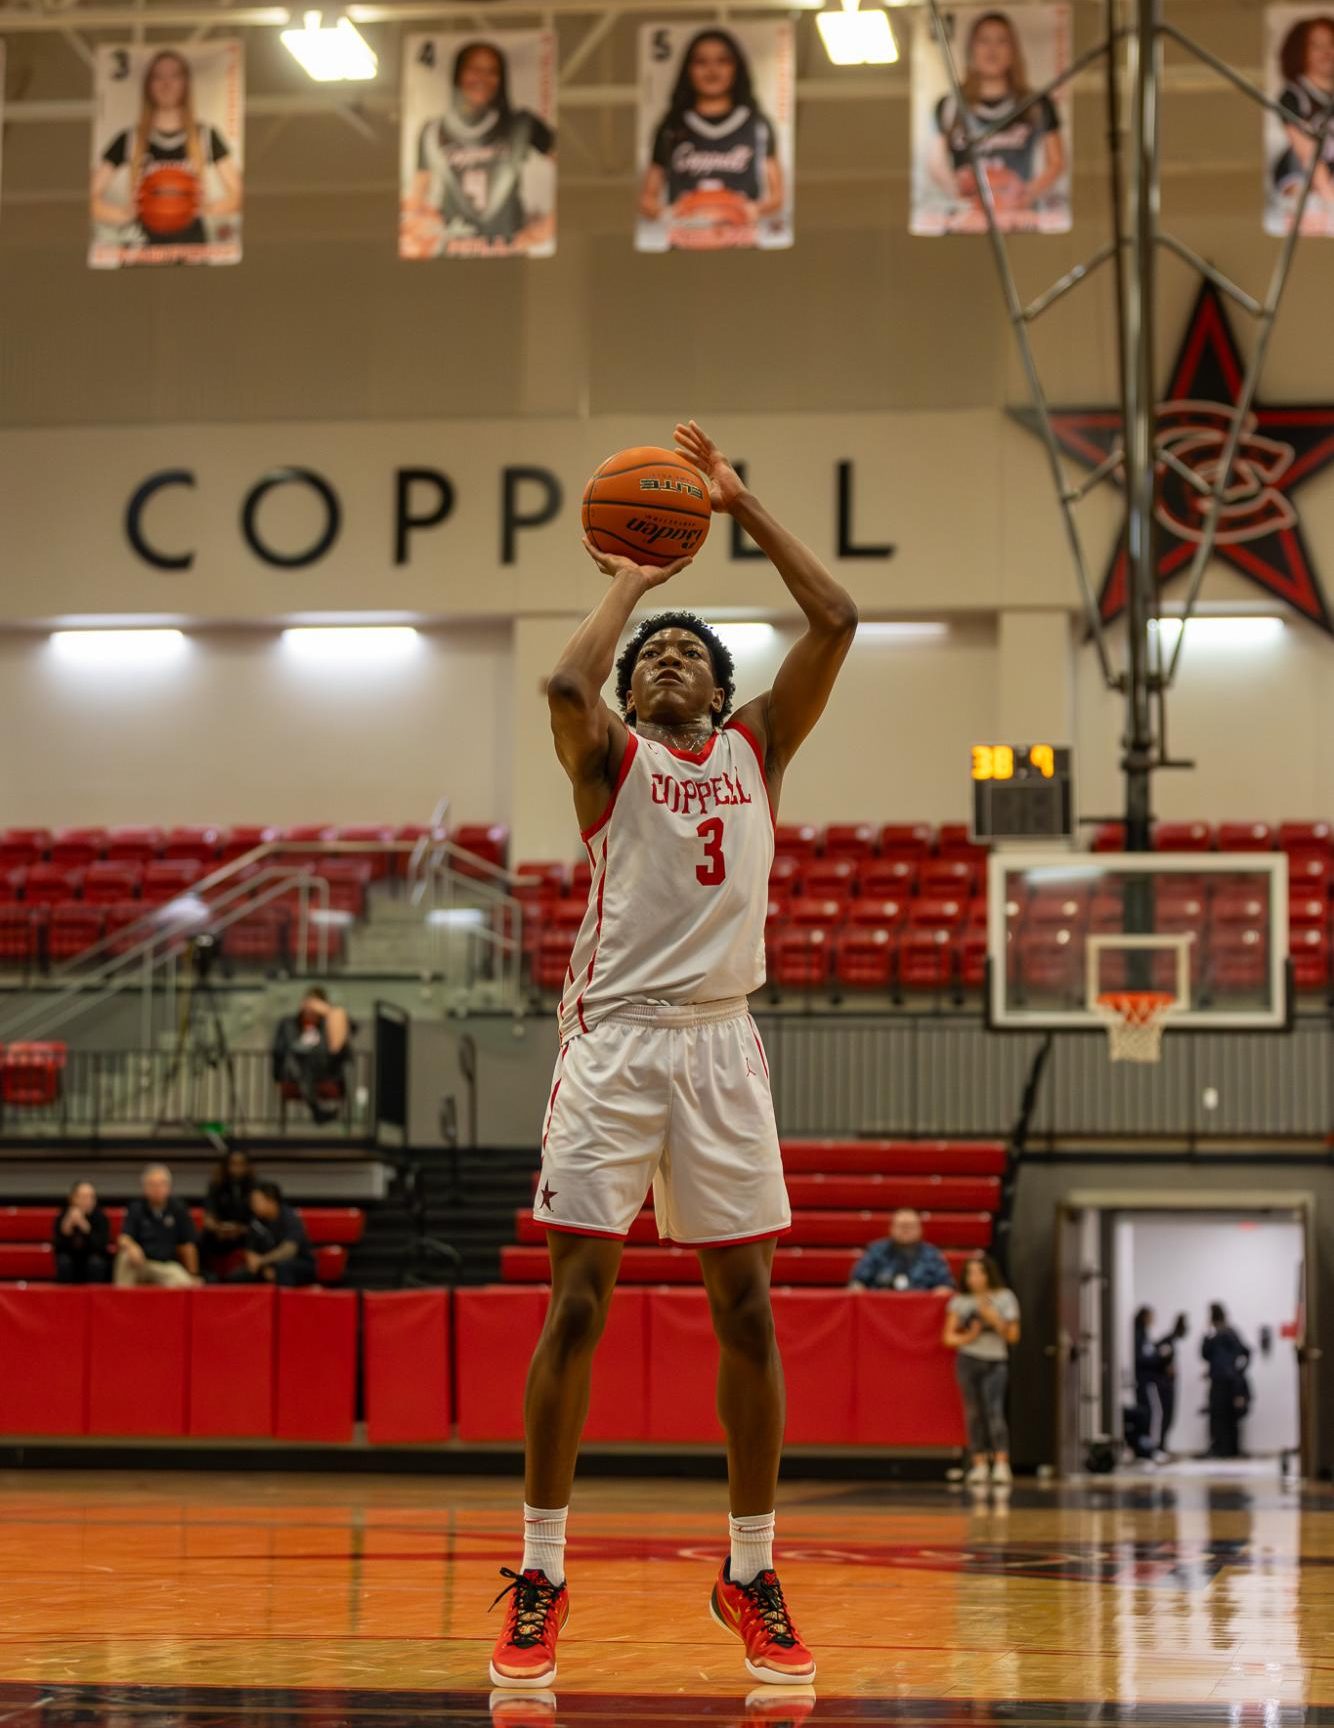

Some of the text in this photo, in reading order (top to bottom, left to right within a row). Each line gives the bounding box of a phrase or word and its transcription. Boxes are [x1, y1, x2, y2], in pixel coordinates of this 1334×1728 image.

[113, 50, 129, 81] 3
[417, 40, 436, 68] 4
[640, 479, 703, 499] ELITE
[125, 460, 896, 571] COPPLL
[626, 517, 703, 549] Baden
[651, 766, 752, 814] COPPELL
[695, 817, 726, 886] 3
